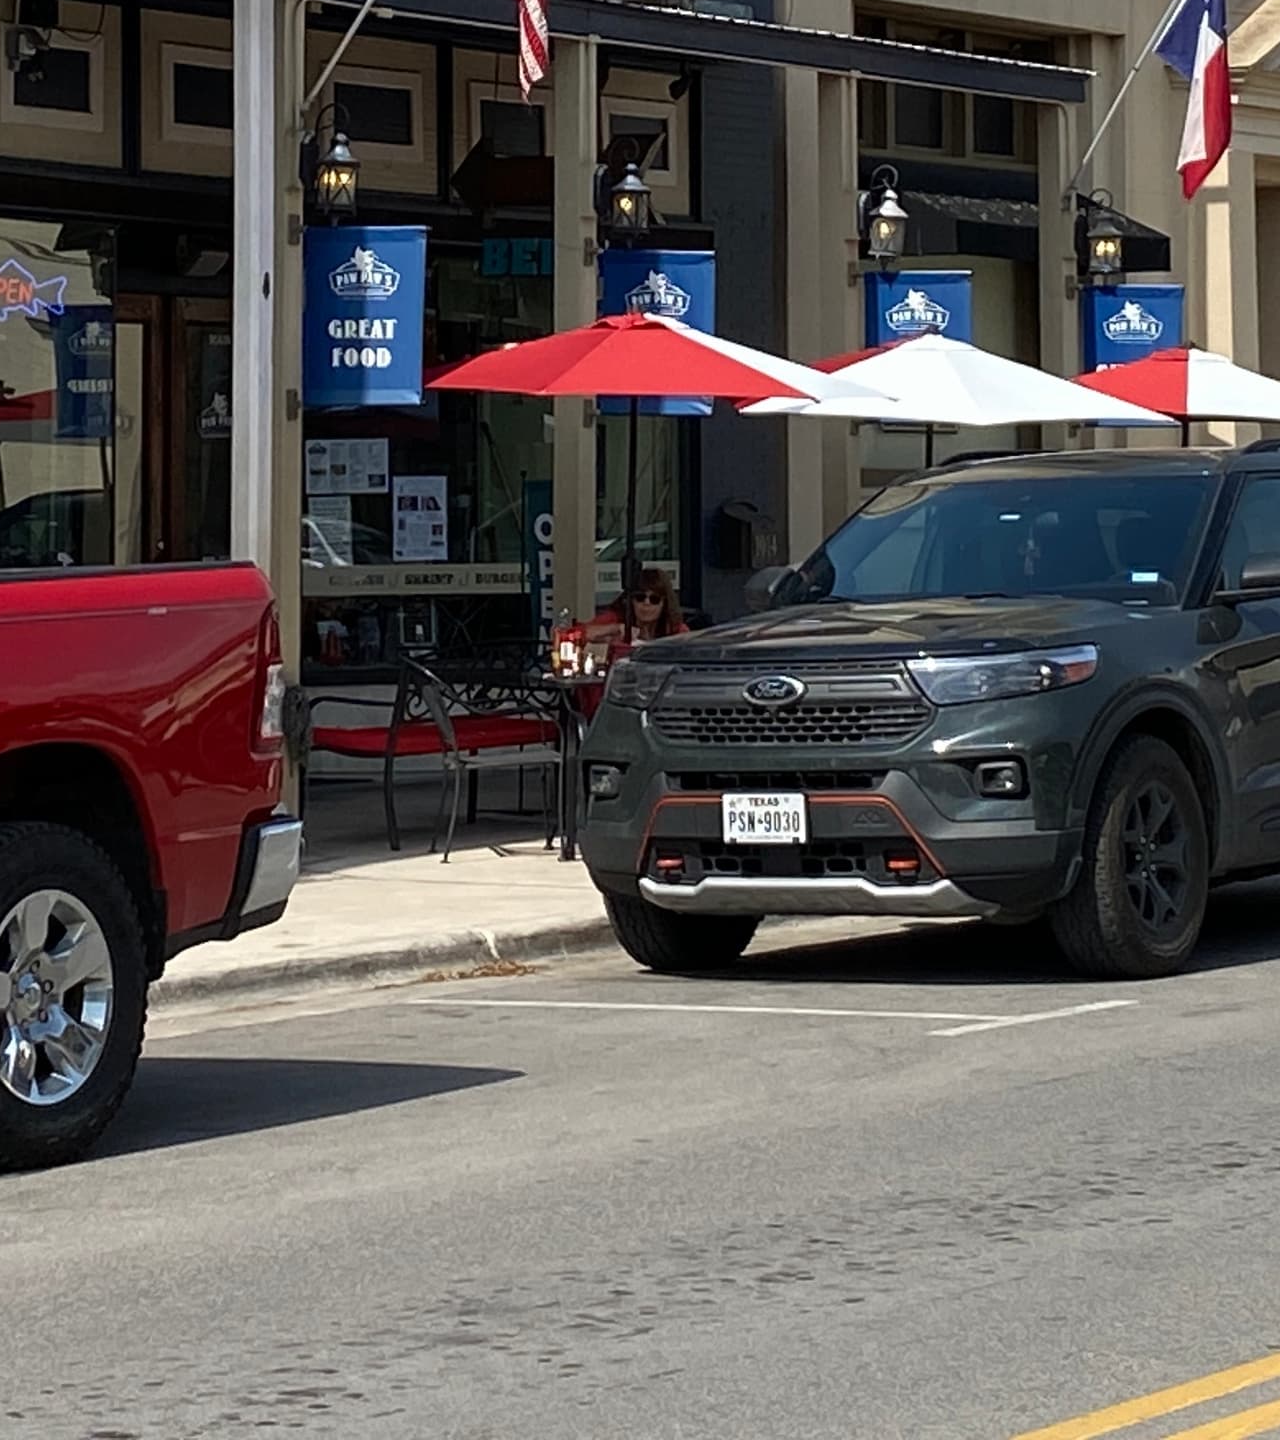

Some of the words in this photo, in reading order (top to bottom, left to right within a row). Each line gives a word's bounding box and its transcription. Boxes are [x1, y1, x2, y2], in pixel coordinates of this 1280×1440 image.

[328, 319, 399, 340] GREAT
[331, 347, 393, 368] FOOD
[747, 797, 780, 807] TEXAS
